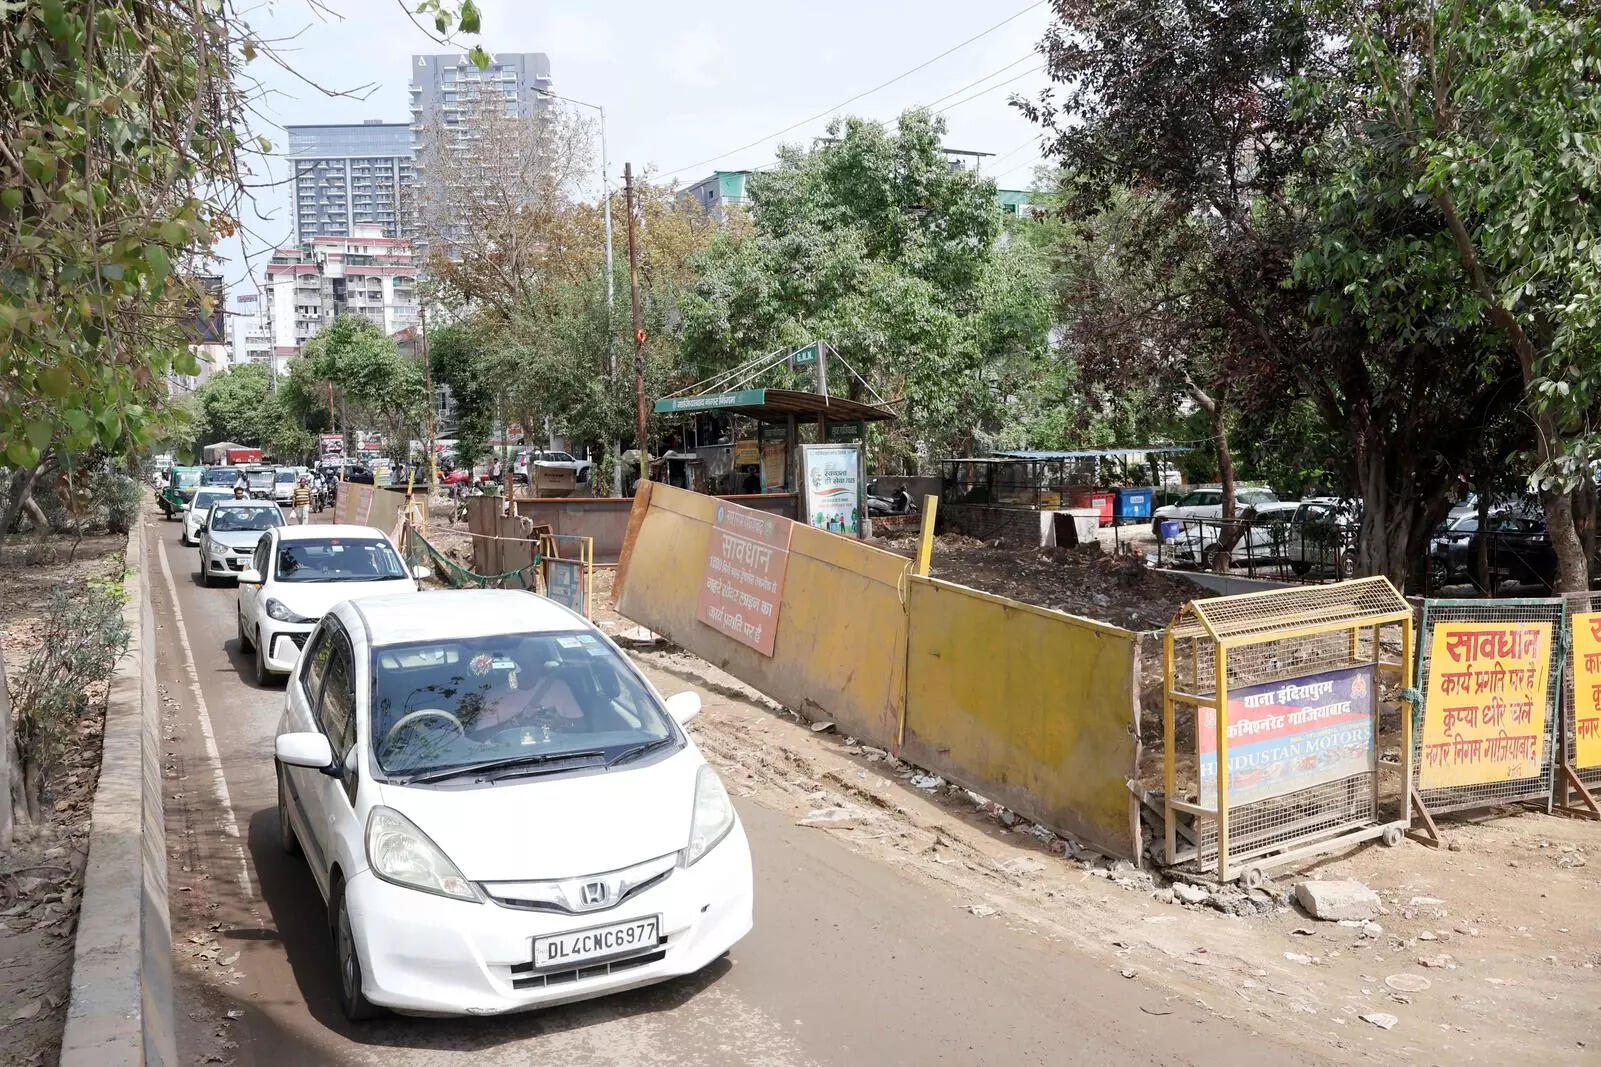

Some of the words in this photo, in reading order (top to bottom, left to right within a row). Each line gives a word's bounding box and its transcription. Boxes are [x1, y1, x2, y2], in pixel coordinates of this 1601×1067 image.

[722, 533, 773, 573] सावधान
[709, 605, 724, 622] कार्य
[723, 611, 743, 633] प्रगति
[744, 622, 754, 639] पर
[755, 623, 762, 644] है
[761, 601, 773, 617] का
[1446, 629, 1540, 662] सावधान
[1244, 691, 1274, 708] थाना
[1277, 680, 1333, 705] इंदिरापुरम
[1441, 664, 1472, 696] कार्य
[1474, 661, 1506, 695] प्रगति
[1508, 669, 1527, 692] पर
[1227, 714, 1286, 738] कमिश्नरेट
[1288, 701, 1351, 725] गाजियाबाद
[1482, 695, 1506, 726] धीरे
[1510, 694, 1534, 725] चलें
[1306, 728, 1371, 753] MOTORS
[1578, 718, 1600, 740] नगर
[1425, 741, 1450, 768] नगर
[1452, 733, 1483, 766] निगम
[1484, 729, 1537, 766] गाजियाबाद
[548, 922, 656, 960] DL4CNC6977
